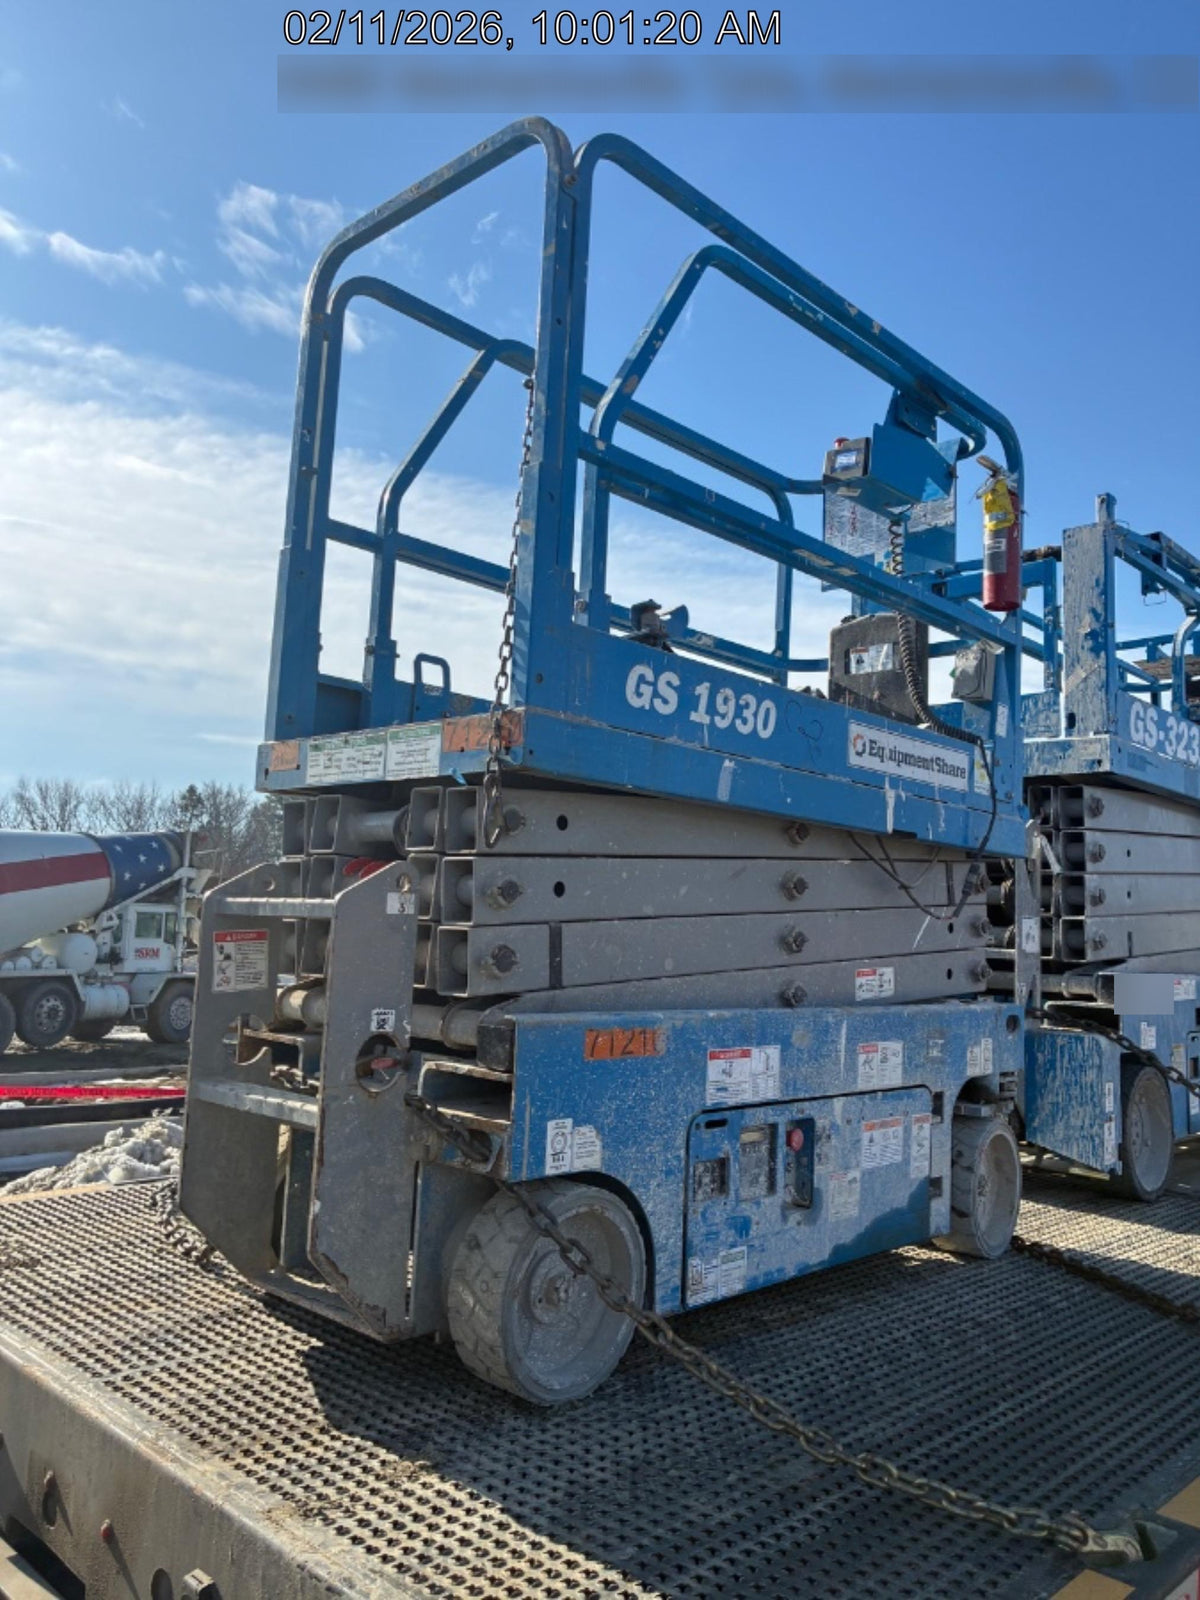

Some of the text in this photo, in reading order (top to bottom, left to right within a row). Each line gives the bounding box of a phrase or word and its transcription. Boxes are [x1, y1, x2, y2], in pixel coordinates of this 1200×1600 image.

[625, 664, 778, 740] GS 1930
[1129, 700, 1200, 766] GS-323
[868, 738, 967, 780] EquipmentShare
